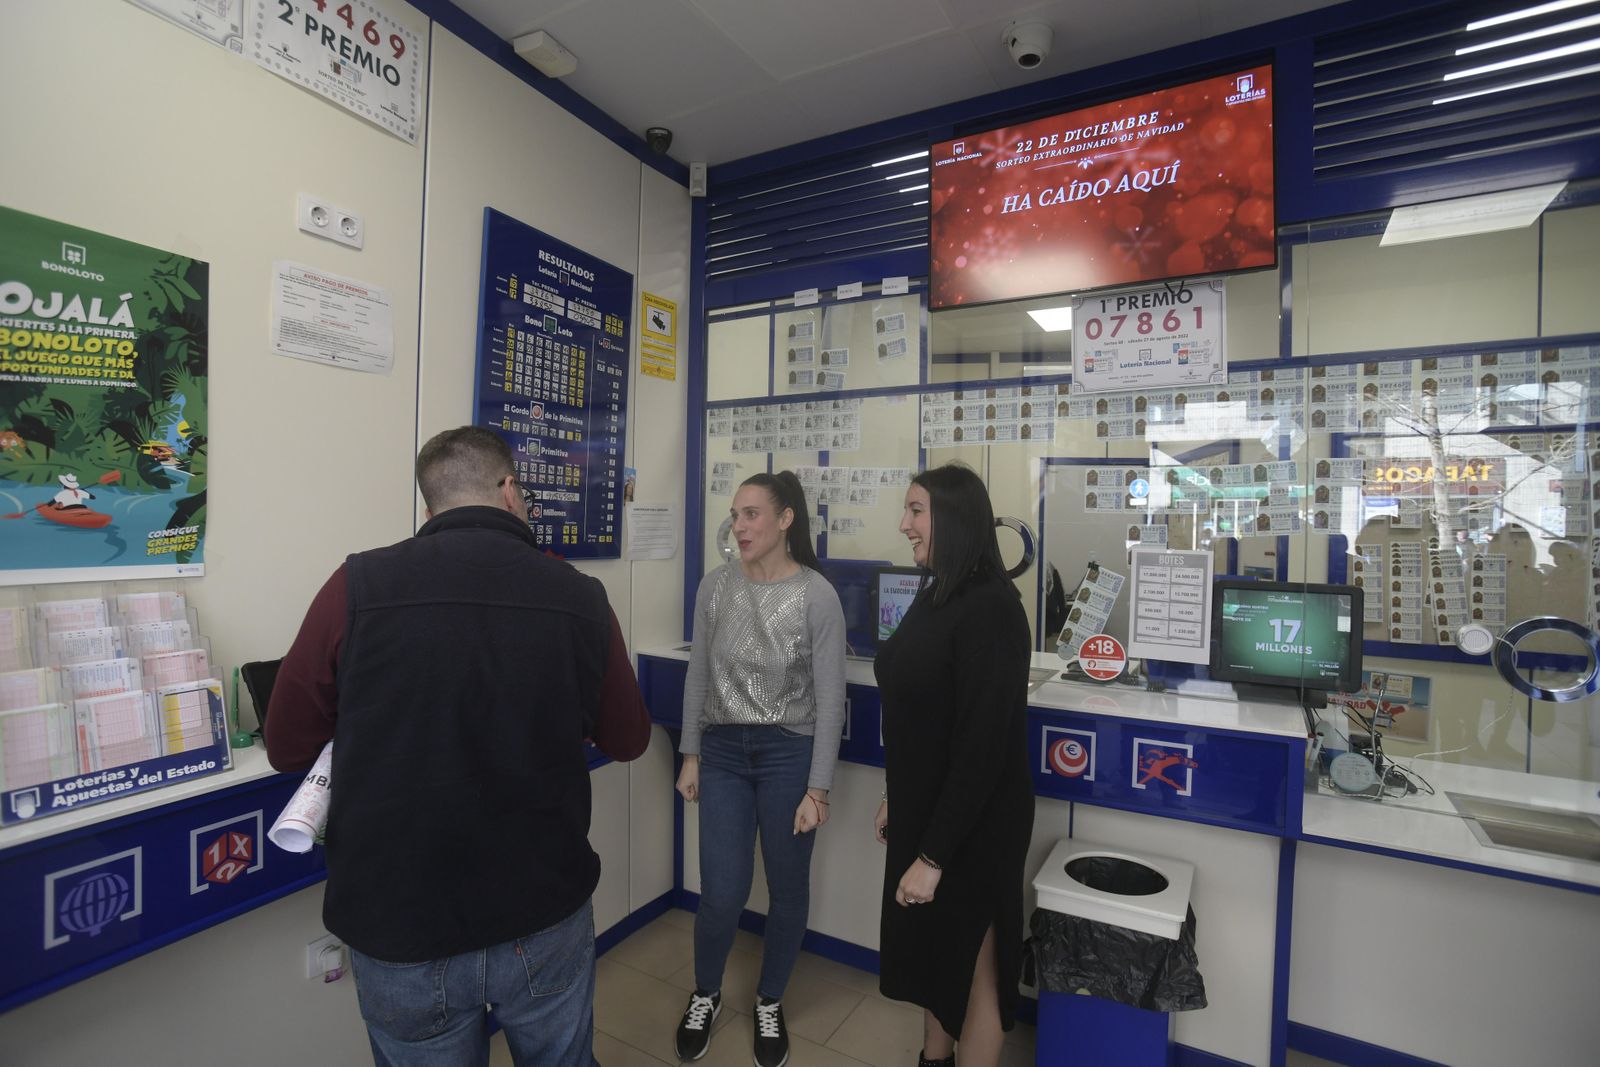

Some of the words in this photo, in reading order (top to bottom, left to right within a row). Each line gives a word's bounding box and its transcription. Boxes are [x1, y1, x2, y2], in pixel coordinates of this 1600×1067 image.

[305, 13, 401, 87] PREMIO
[1225, 88, 1266, 103] LOTERÍAS
[1015, 138, 1034, 154] 22
[1038, 134, 1059, 149] DE
[1063, 111, 1160, 144] DICIEMBRE
[995, 155, 1030, 169] SORTEO
[1032, 136, 1118, 162] EXTRAORDINARIO
[1119, 131, 1135, 142] DE
[1135, 121, 1185, 141] NAVIDAD
[1000, 194, 1033, 215] HA
[1037, 178, 1110, 208] CAÍDO
[1113, 159, 1182, 194] AQUÍ
[41, 260, 105, 282] BONOLOTO
[538, 249, 595, 282] RESULTADOS
[538, 265, 558, 279] Lotería
[570, 278, 593, 293] Nacional
[0, 281, 135, 328] OJALÁ
[1116, 289, 1193, 311] PREMIO
[0, 318, 55, 331] CIERTES
[58, 324, 67, 332] A
[68, 325, 83, 334] LA
[84, 327, 138, 339] PRIMERA.
[524, 314, 542, 328] Bono
[557, 325, 573, 337] Loto
[1085, 306, 1203, 340] 07861
[0, 328, 139, 359] BONOLOTO,
[15, 350, 70, 364] JUEGO
[71, 355, 103, 366] QUE
[104, 356, 134, 369] MÁS
[1143, 358, 1172, 367] Nacional
[0, 362, 102, 377] PORTUNIDADES
[103, 369, 118, 378] TE
[119, 370, 136, 380] DA.
[503, 403, 510, 412] El
[510, 405, 530, 416] Gordo
[559, 415, 583, 426] Primitiva
[518, 443, 526, 452] La
[541, 446, 569, 458] Primitiva
[147, 525, 200, 539] CONSIGUE
[147, 534, 198, 548] GRANDES
[147, 542, 197, 556] PREMIOS
[1158, 555, 1185, 566] BOTES
[1268, 618, 1302, 643] 17
[1088, 639, 1115, 655] +18
[1255, 642, 1313, 655] MILLONES
[51, 780, 134, 808] Apuestas
[138, 771, 163, 786] del
[167, 760, 216, 780] Estado
[53, 770, 126, 795] Loterías
[129, 766, 141, 779] y
